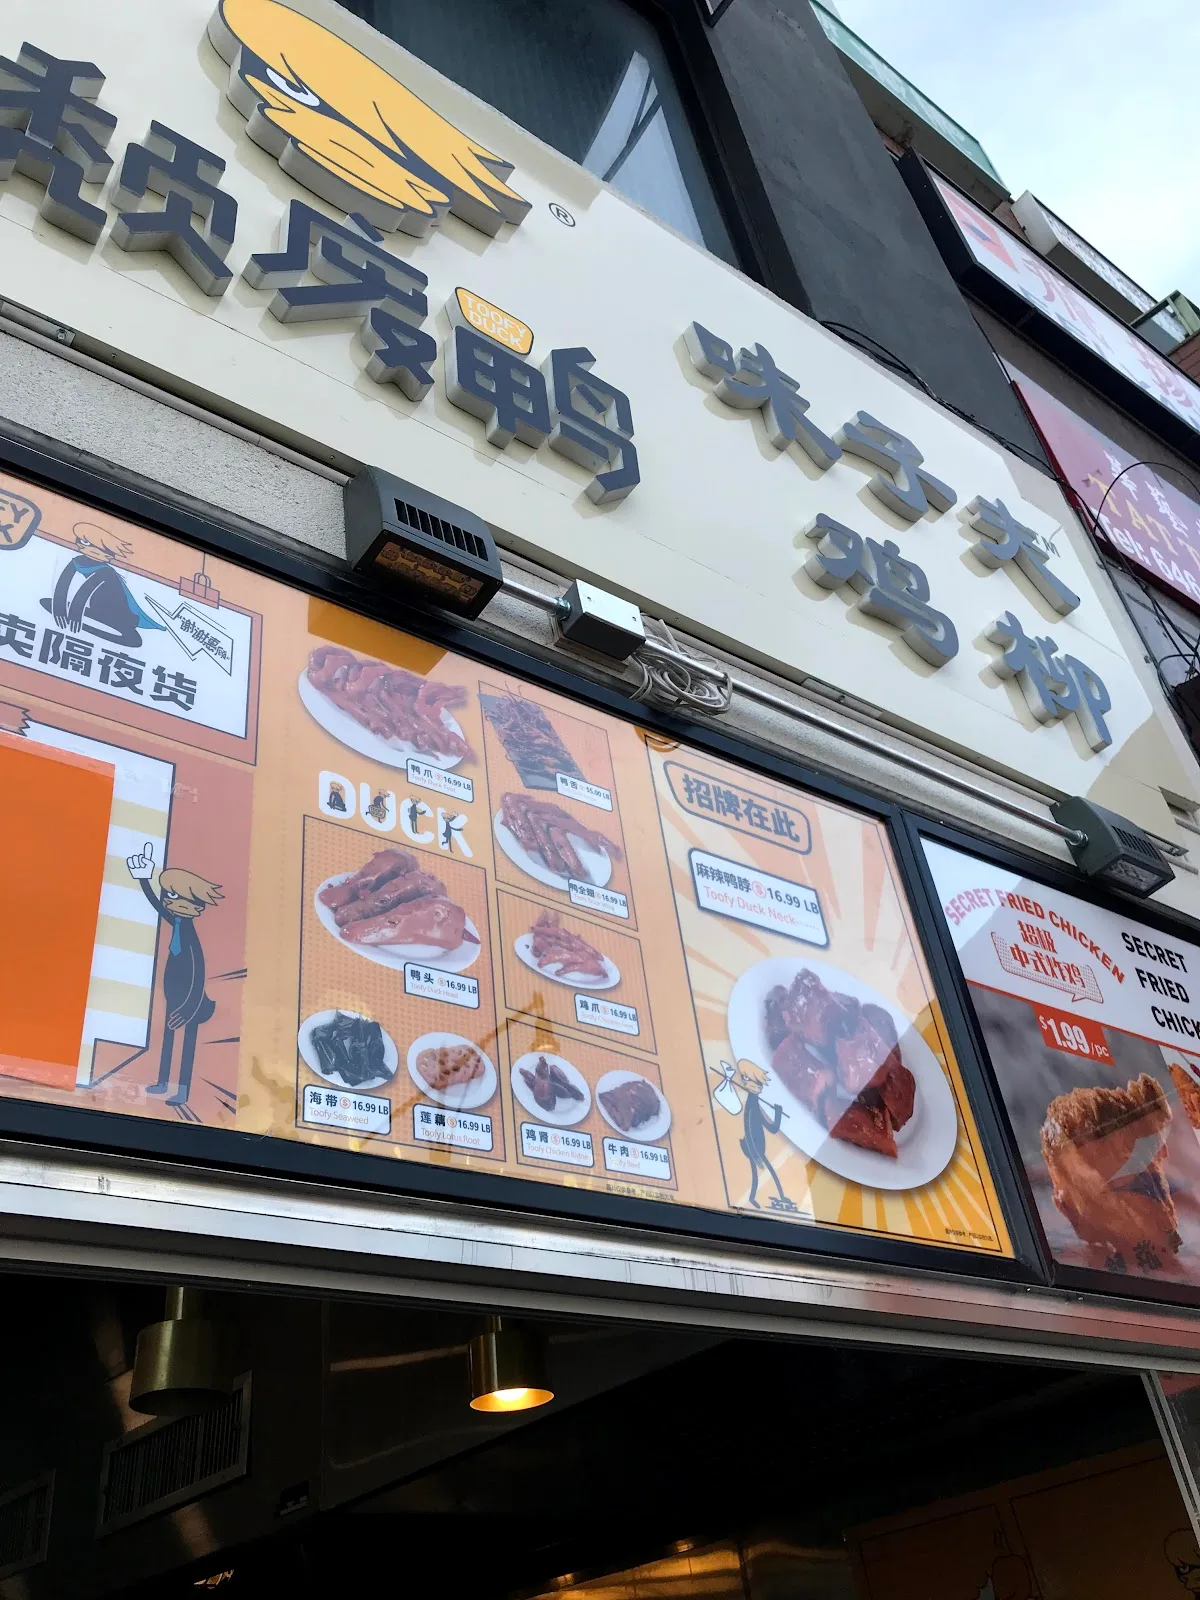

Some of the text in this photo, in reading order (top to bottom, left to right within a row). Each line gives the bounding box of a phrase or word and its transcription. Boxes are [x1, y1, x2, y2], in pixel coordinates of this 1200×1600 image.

[464, 293, 526, 337] TOOFY
[469, 310, 523, 350] DUCK
[1090, 506, 1151, 566] Tel:
[803, 513, 1111, 750] 鸡柳
[463, 783, 472, 791] LB
[319, 770, 473, 858] DUCK
[683, 773, 800, 842] 招牌在此
[704, 885, 734, 908] Toofy
[738, 897, 765, 915] Duck
[767, 887, 800, 908] 16.99
[804, 899, 819, 915] LB
[945, 888, 1125, 984] SECRET FRIED CHICKEN
[1017, 920, 1058, 954] 超级
[1009, 942, 1086, 989] 中式炸鸡
[1121, 932, 1188, 974] SECRET
[410, 969, 477, 994] 鸭头 16.99 LB
[1135, 967, 1190, 1004] FRIED
[610, 1008, 627, 1019] 16.99
[629, 1013, 637, 1022] LB
[309, 1107, 369, 1125] Toofy Seaweed
[310, 1091, 337, 1107] 海带
[352, 1100, 376, 1113] 16.99
[378, 1105, 389, 1115] LB
[421, 1127, 481, 1145] Toofy Lotus Root
[458, 1119, 479, 1131] 16.99
[481, 1123, 491, 1133] LB
[561, 1136, 580, 1148] 16.99
[582, 1140, 591, 1150] LB
[608, 1143, 668, 1163] 牛肉 16.99 LB
